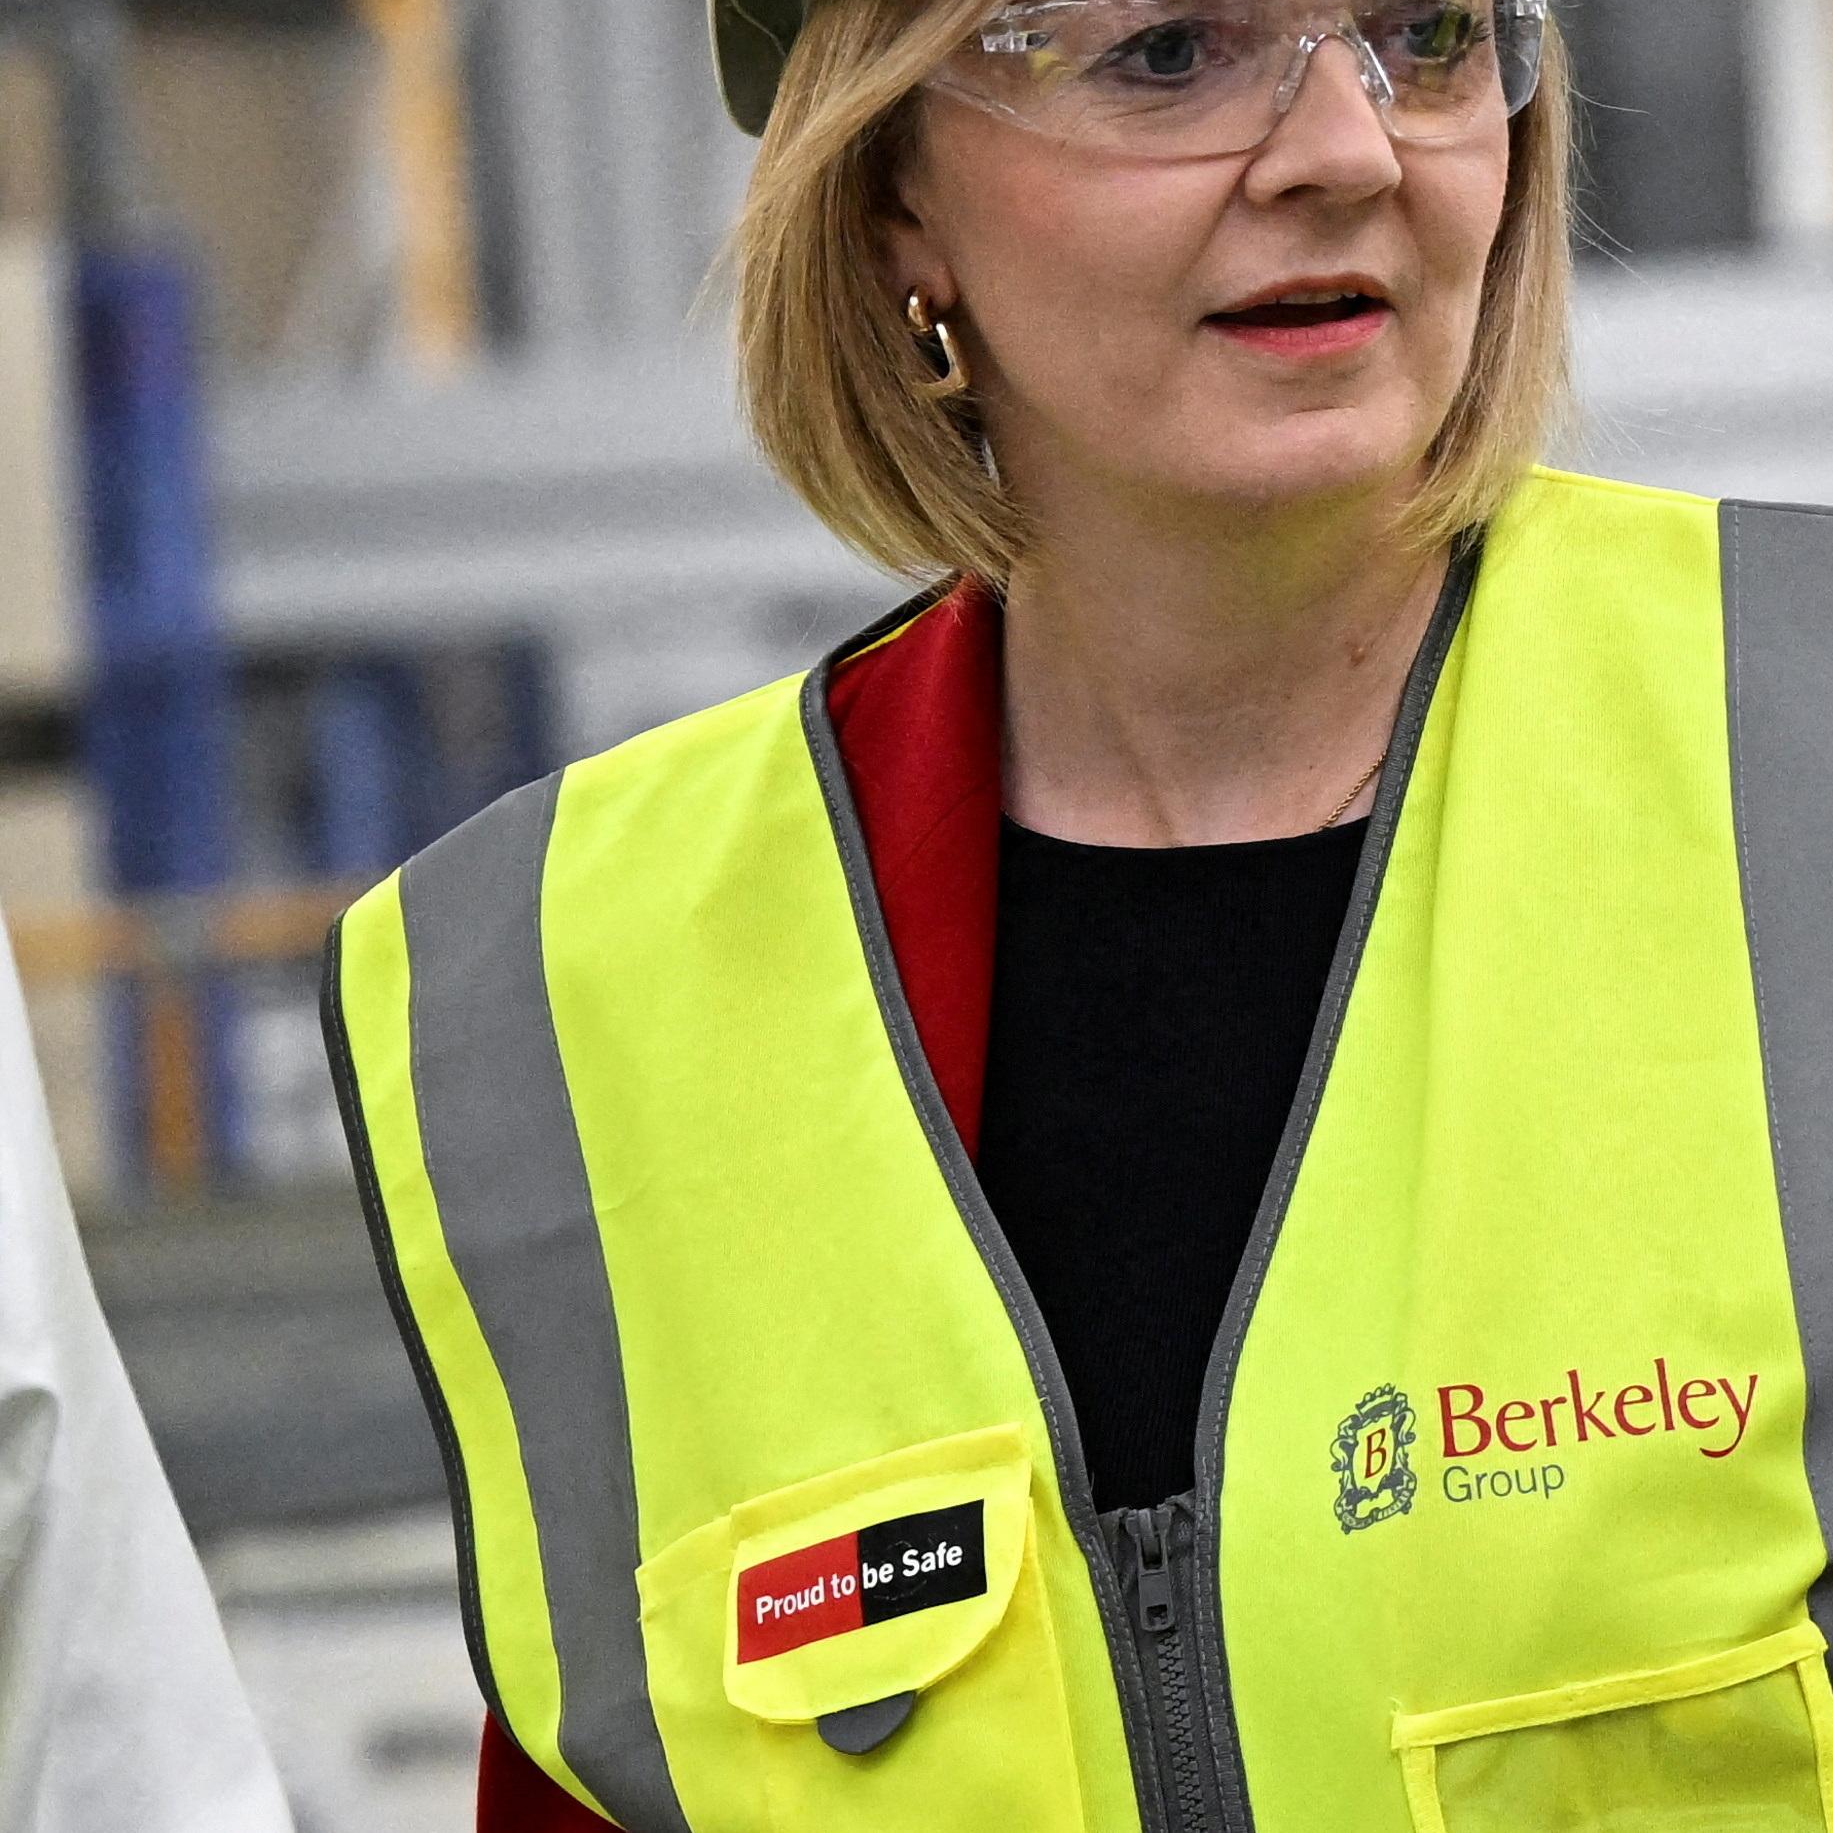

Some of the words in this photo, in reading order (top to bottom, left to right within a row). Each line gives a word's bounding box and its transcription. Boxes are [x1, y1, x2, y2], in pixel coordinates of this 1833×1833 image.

[1437, 1357, 1758, 1459] Berkeley
[1365, 1428, 1387, 1479] B
[1443, 1462, 1565, 1502] Group
[755, 1577, 825, 1624] Proud
[830, 1573, 856, 1599] to
[862, 1562, 894, 1589] be
[902, 1541, 963, 1577] Safe
